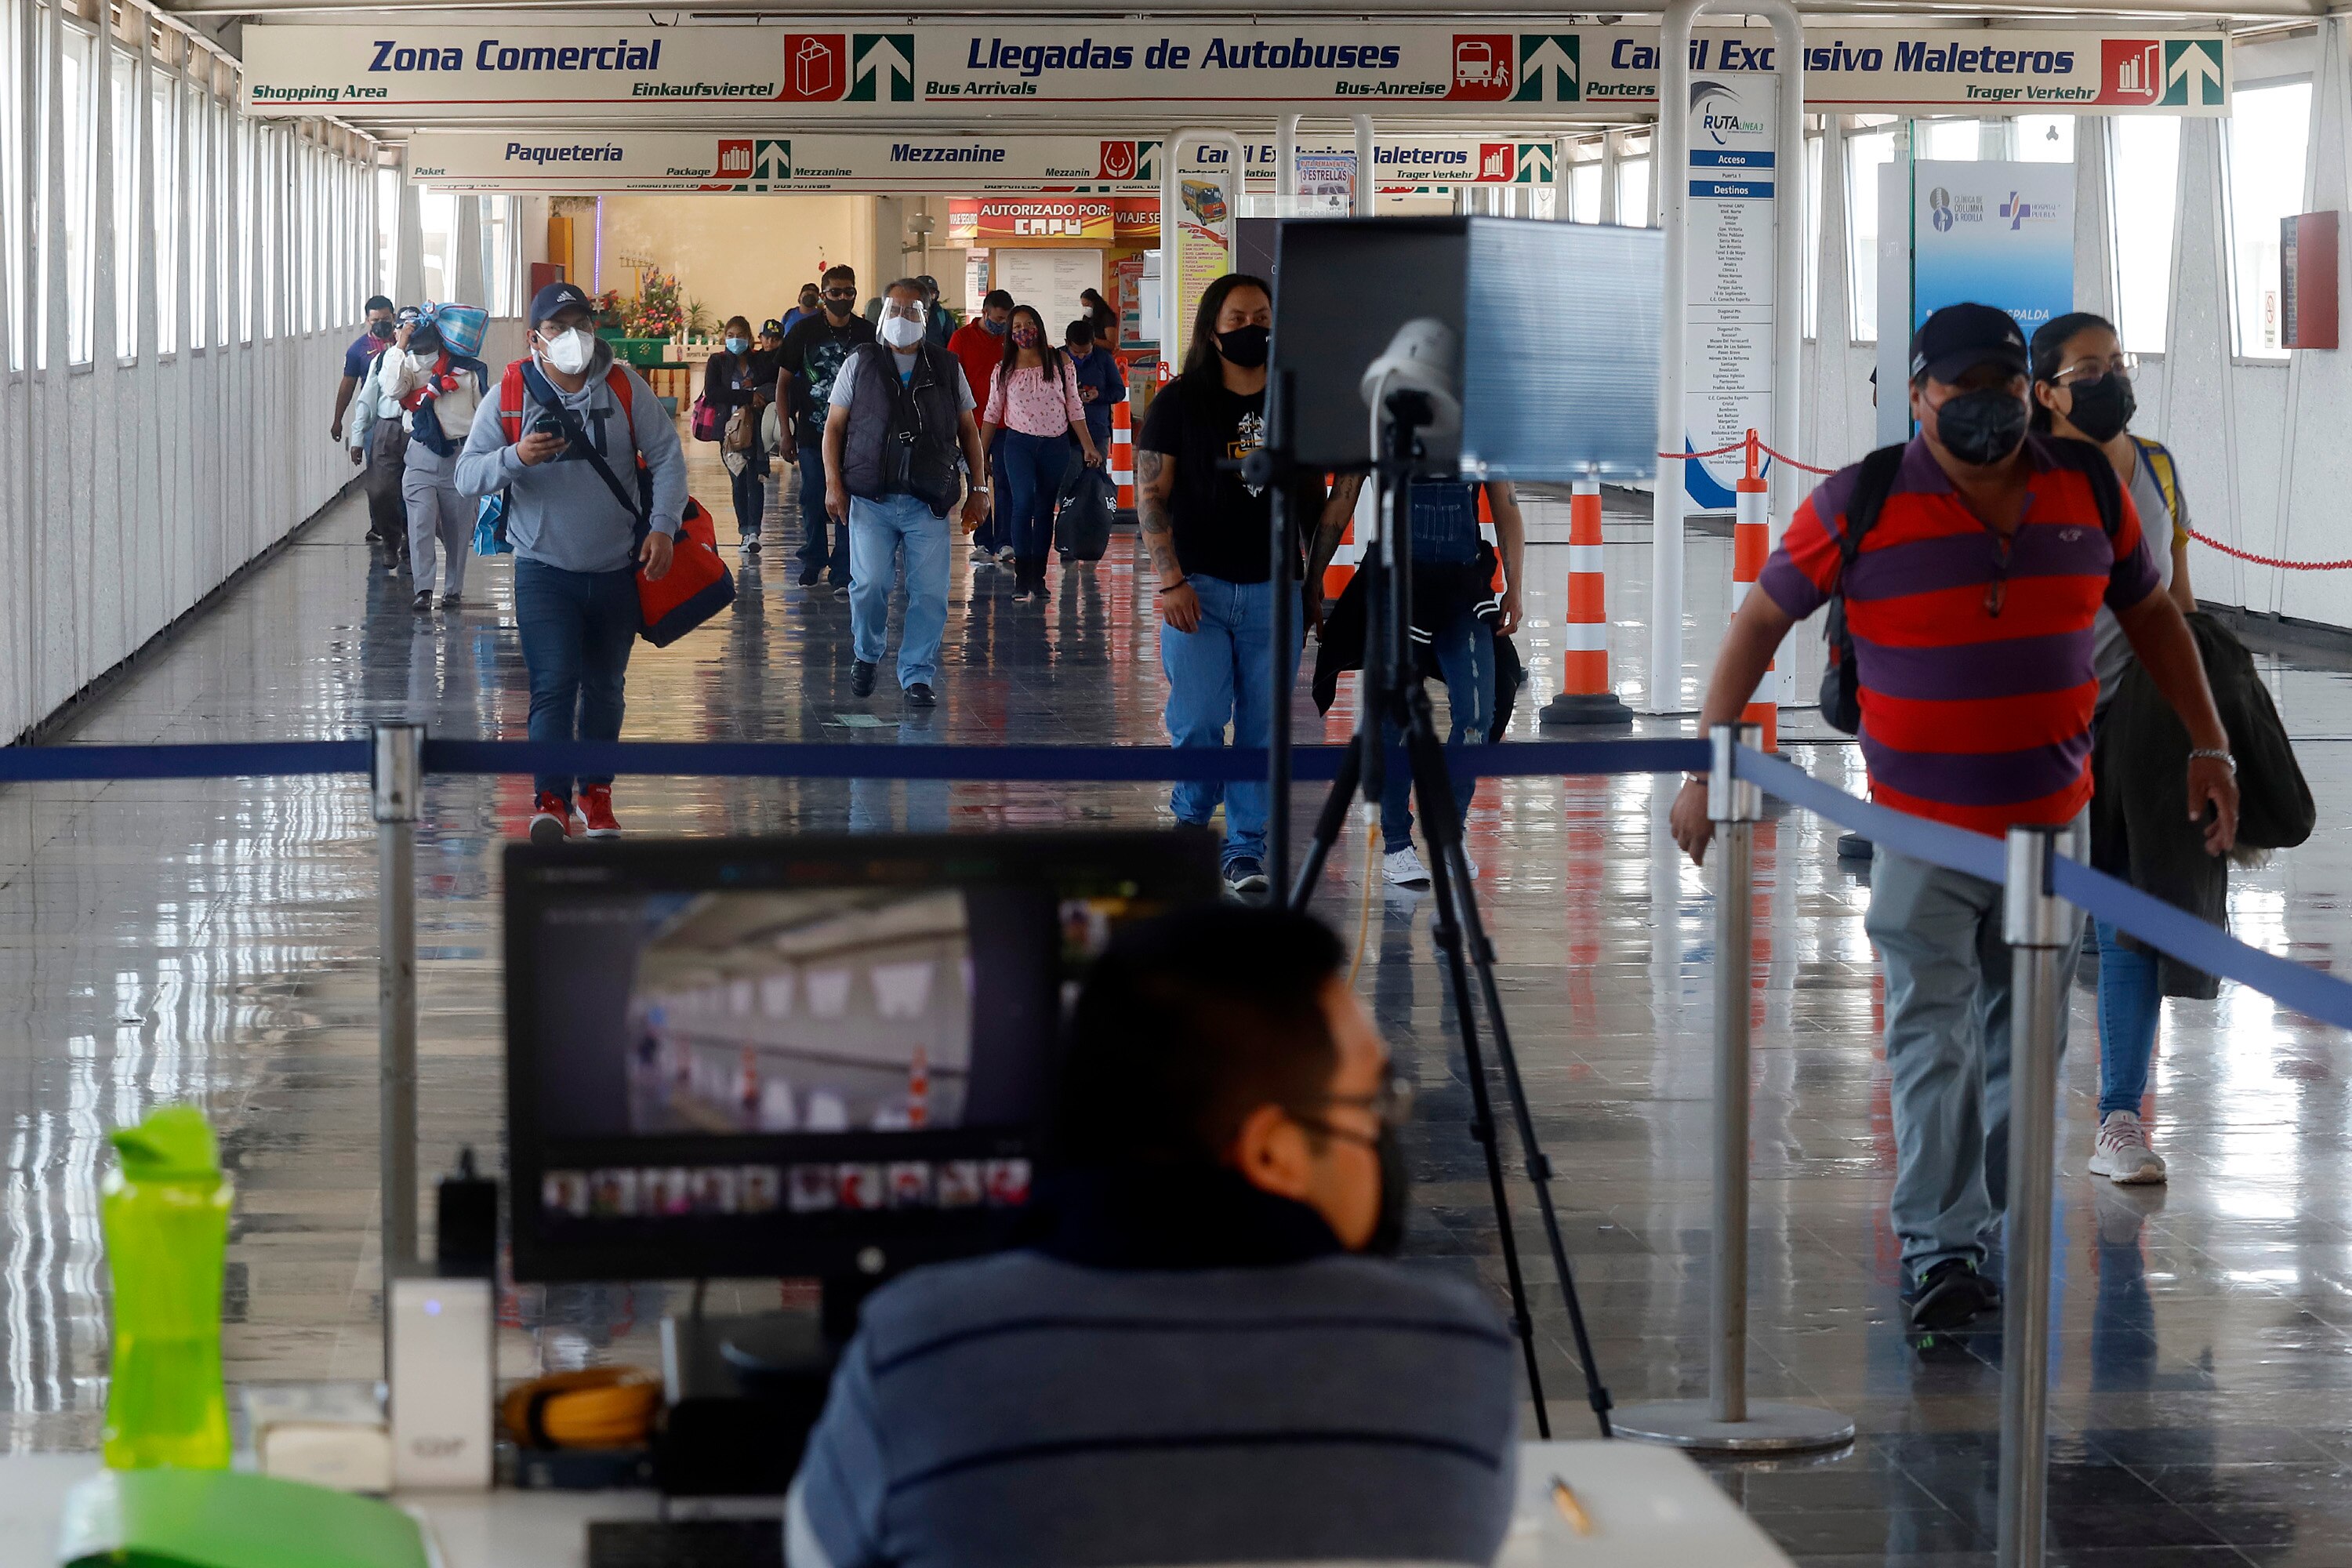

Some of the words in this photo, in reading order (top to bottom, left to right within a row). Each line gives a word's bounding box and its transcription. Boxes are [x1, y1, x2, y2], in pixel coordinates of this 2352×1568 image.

[368, 41, 463, 72] Zona
[476, 38, 662, 71] Comercial
[967, 38, 1134, 78] Llegadas
[1145, 38, 1191, 70] de
[1200, 37, 1401, 69] Autobuses
[1610, 38, 1710, 70] Caril
[1893, 41, 2074, 74] Maleteros
[251, 85, 339, 102] Shopping
[342, 85, 388, 98] Area
[632, 82, 774, 96] Einkaufsviertel
[925, 81, 961, 95] Bus
[963, 81, 1037, 95] Arrivals
[1334, 81, 1446, 95] Bus-Anreise
[1585, 82, 1656, 96] Porters
[1965, 85, 2023, 101] Trager
[2027, 85, 2096, 100] Verkehr
[1703, 115, 1740, 130] RUTA
[1739, 121, 1758, 131] LÍNEA
[505, 142, 623, 165] Paquetería
[890, 143, 1006, 162] Mezzanine
[1196, 145, 1254, 163] Caril
[1718, 155, 1746, 164] Acceso
[414, 167, 445, 176] Paket
[666, 167, 712, 177] Package
[793, 168, 852, 176] Mezzanine
[1045, 168, 1090, 177] Mezzanin
[1308, 169, 1349, 184] ESTRELLAS)
[1397, 169, 1431, 180] Trager
[1432, 170, 1473, 179] Verkehr
[1714, 185, 1749, 194] Destinos
[980, 204, 1075, 216] AUTORIZADO
[1078, 204, 1110, 216] POR:
[1954, 204, 1983, 213] COLUMNA
[1115, 212, 1146, 223] VIAJE
[1960, 213, 1983, 221] RODILLA
[1014, 219, 1082, 235] CAPU
